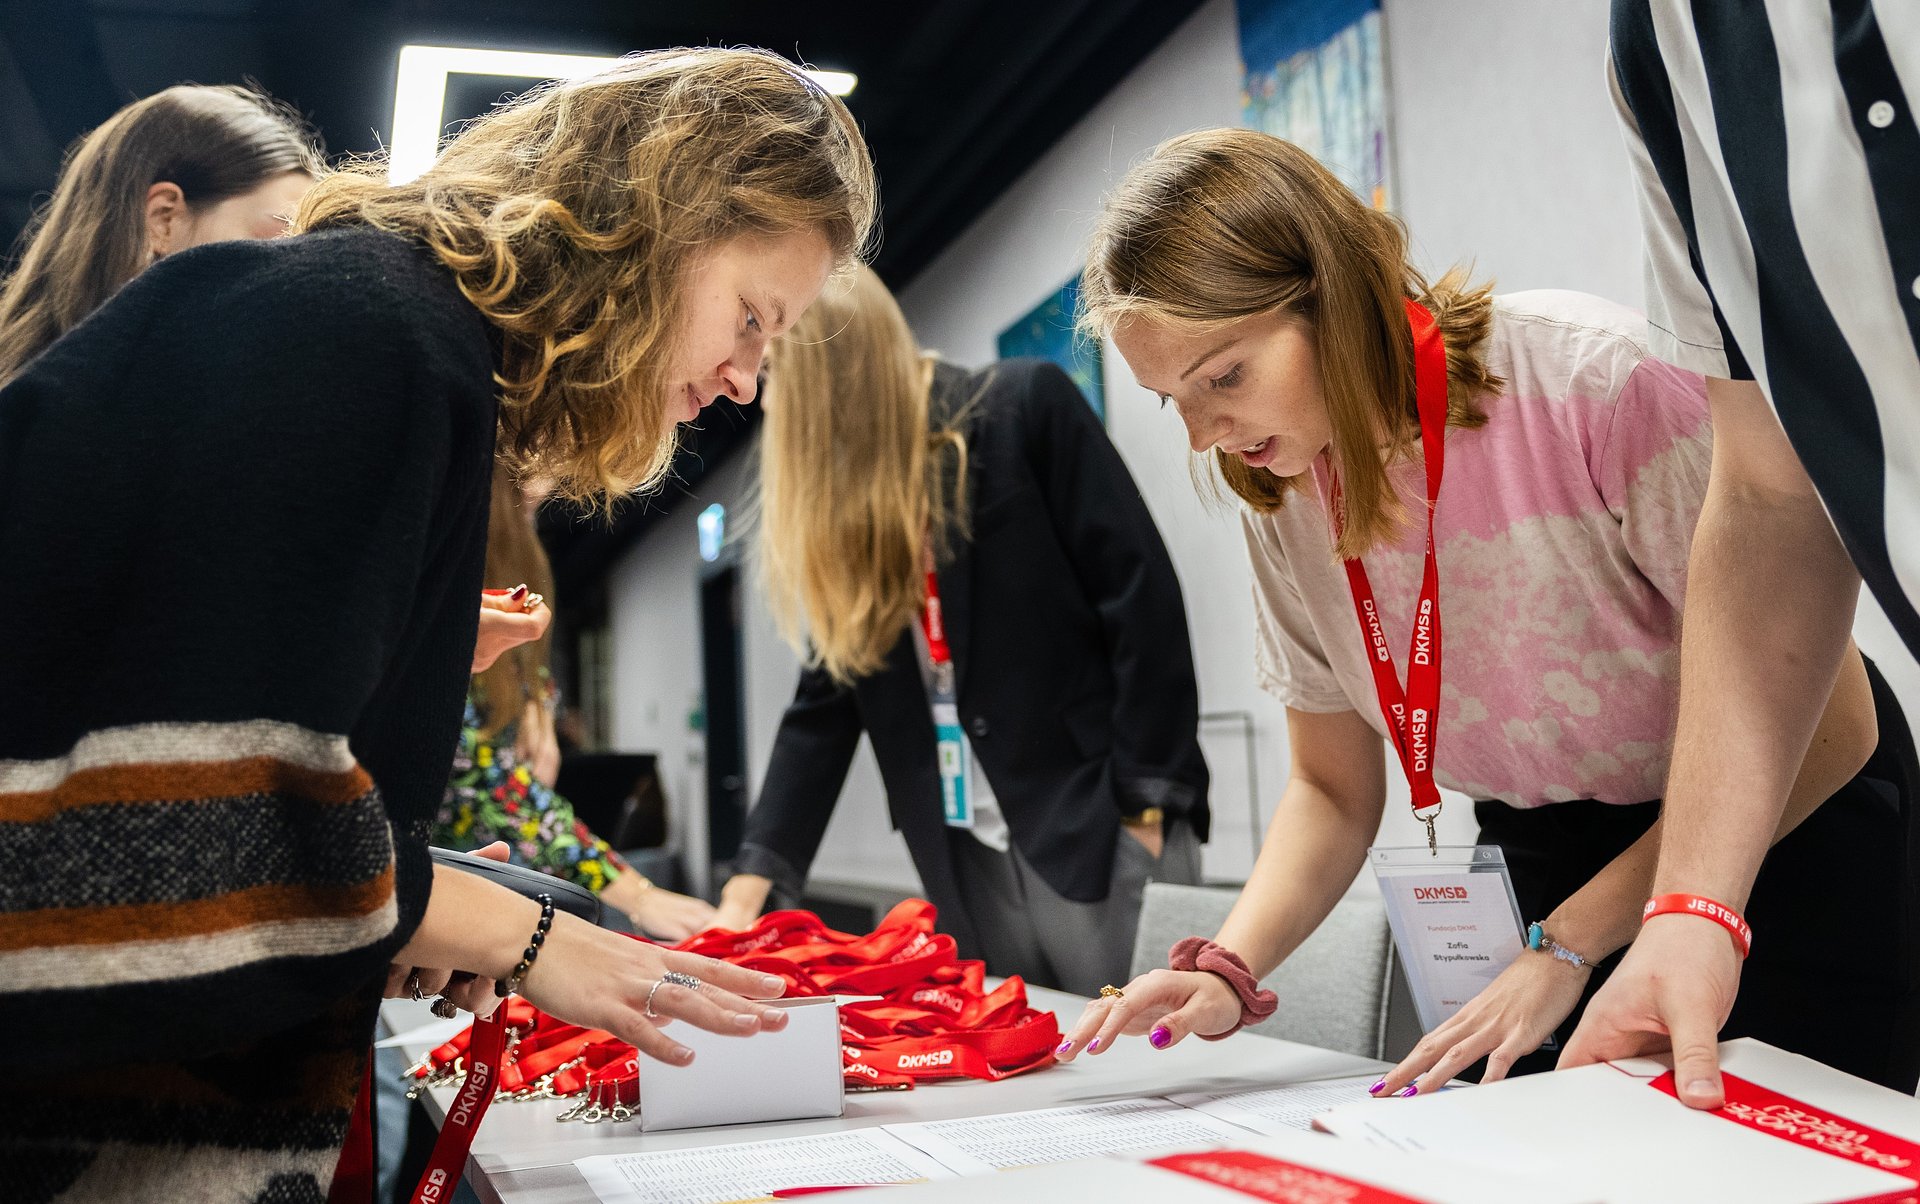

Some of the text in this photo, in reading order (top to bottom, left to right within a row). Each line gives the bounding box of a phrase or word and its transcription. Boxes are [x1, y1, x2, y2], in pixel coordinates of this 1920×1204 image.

[1363, 599, 1385, 647] DKMS
[1415, 614, 1430, 665] DKMS
[1412, 722, 1427, 772] DKMS
[1413, 886, 1455, 900] DKMS
[1687, 898, 1746, 935] JESTEM Z
[1446, 941, 1469, 949] Zofia
[897, 1051, 940, 1068] DKMS
[452, 1075, 489, 1127] DKMS
